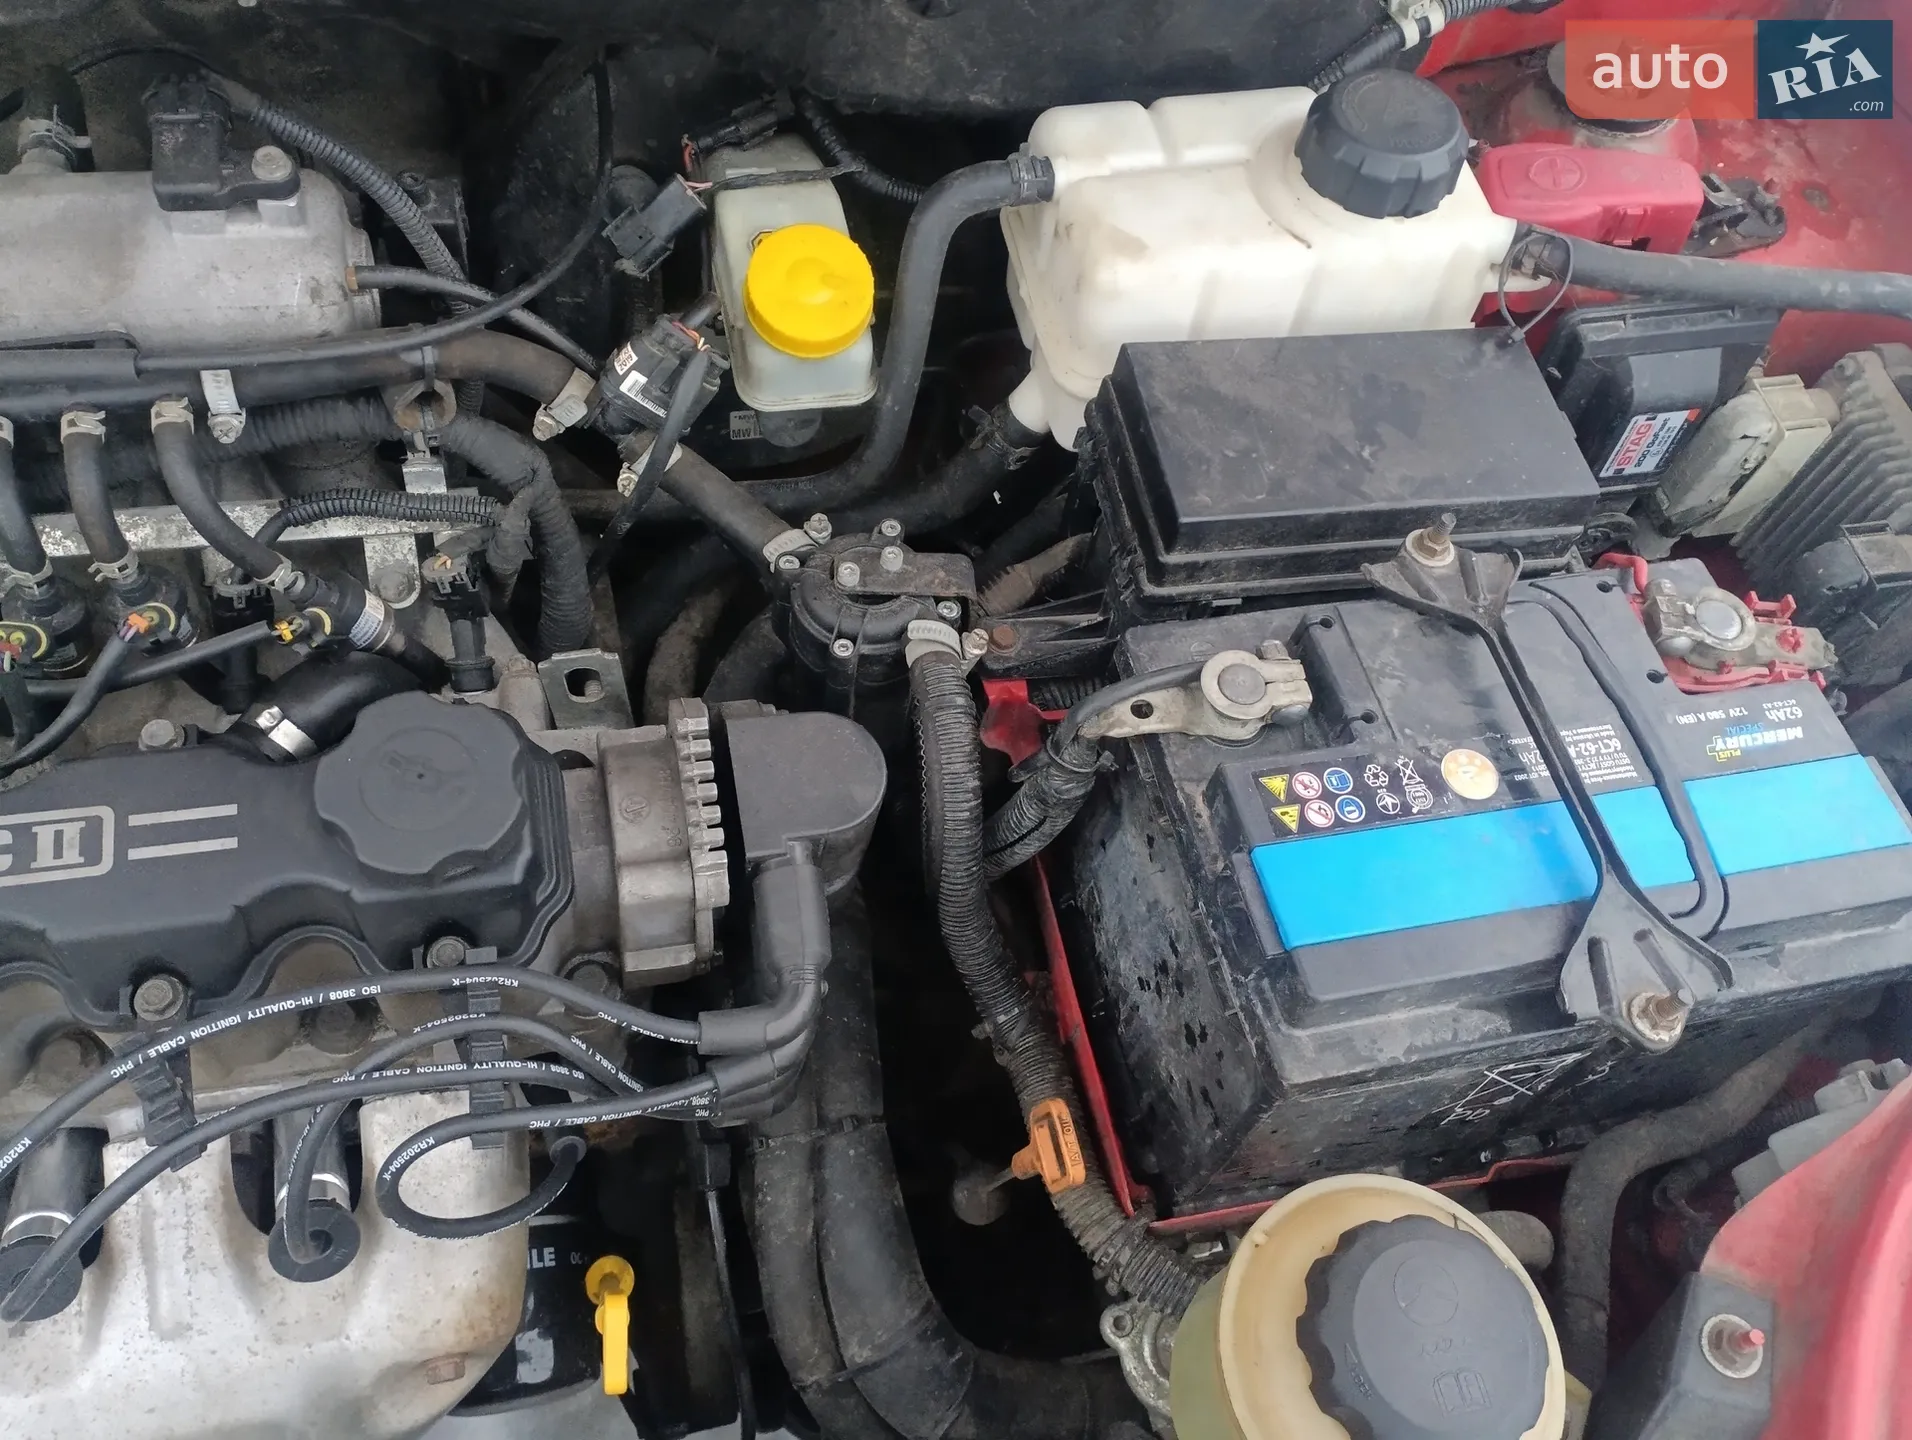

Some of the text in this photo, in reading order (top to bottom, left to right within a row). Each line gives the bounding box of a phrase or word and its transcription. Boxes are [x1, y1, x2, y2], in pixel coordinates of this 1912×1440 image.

[1616, 423, 1653, 467] STAG
[1697, 712, 1706, 722] A
[1728, 706, 1748, 718] 12V
[1765, 706, 1803, 722] 62Ah
[1724, 722, 1764, 735] SPECIAL
[1715, 725, 1804, 751] MERCURY
[1518, 749, 1544, 766] 2Ah
[1718, 748, 1742, 759] PLUS
[329, 988, 356, 1001] 3808
[361, 984, 381, 996] ISO
[247, 995, 314, 1020] HI-QUALITY
[190, 1014, 242, 1040] IGNITION
[147, 1035, 186, 1059] CABLE
[570, 1035, 587, 1052] PHC
[110, 1060, 135, 1079] PHC
[416, 1062, 467, 1074] IGNITION
[473, 1060, 538, 1070] HI-QUALITY
[594, 1051, 616, 1074] CABLE
[371, 1067, 411, 1078] CABLE
[529, 1119, 551, 1129] PHC
[0, 1136, 33, 1172] KR202
[382, 1136, 436, 1181] KR202504-K
[527, 1247, 557, 1270] LE
